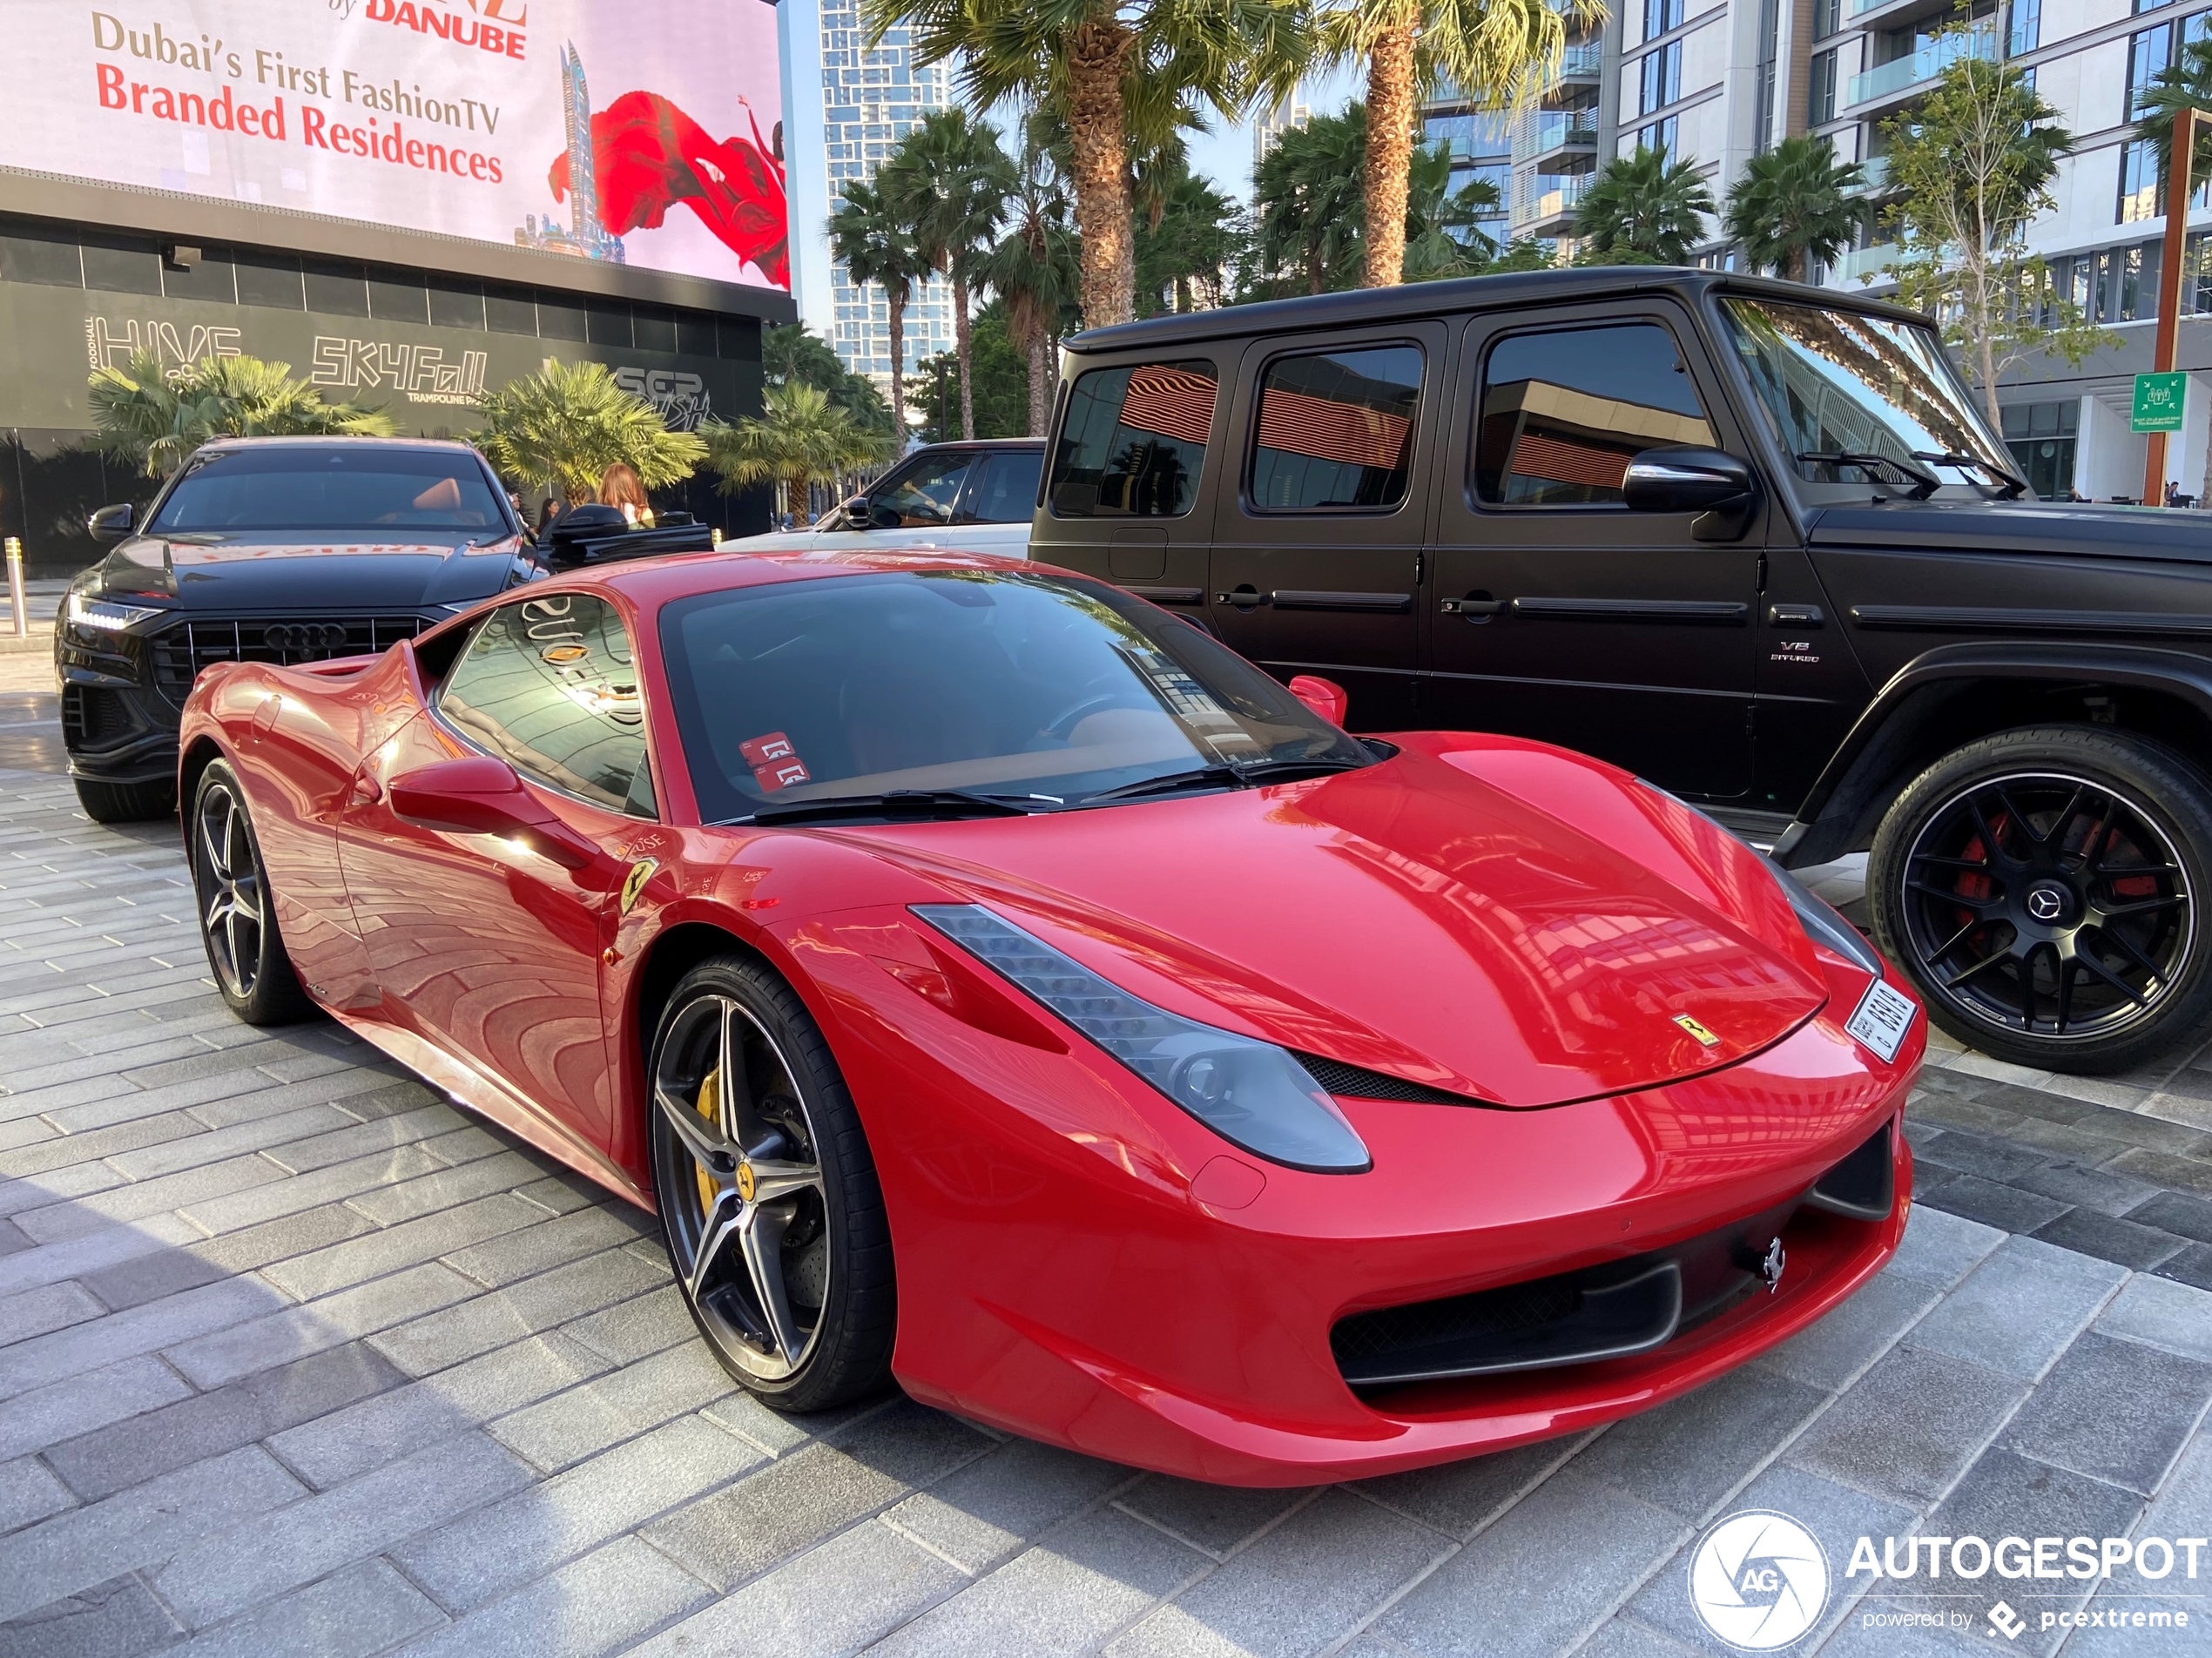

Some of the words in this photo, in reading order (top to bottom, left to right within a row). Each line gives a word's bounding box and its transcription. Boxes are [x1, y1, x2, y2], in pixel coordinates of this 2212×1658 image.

[366, 0, 527, 61] DANUBE
[91, 10, 242, 79] Dubai's
[254, 50, 333, 100] First
[342, 70, 500, 136] FashionTV
[95, 63, 287, 141] Branded
[302, 105, 503, 184] Residences
[85, 316, 98, 370] FOODHALL
[407, 392, 465, 406] TRAMPOLINE
[1770, 654, 1820, 663] BITURBO
[1780, 641, 1811, 651] V8
[1867, 987, 1908, 1032] 85919
